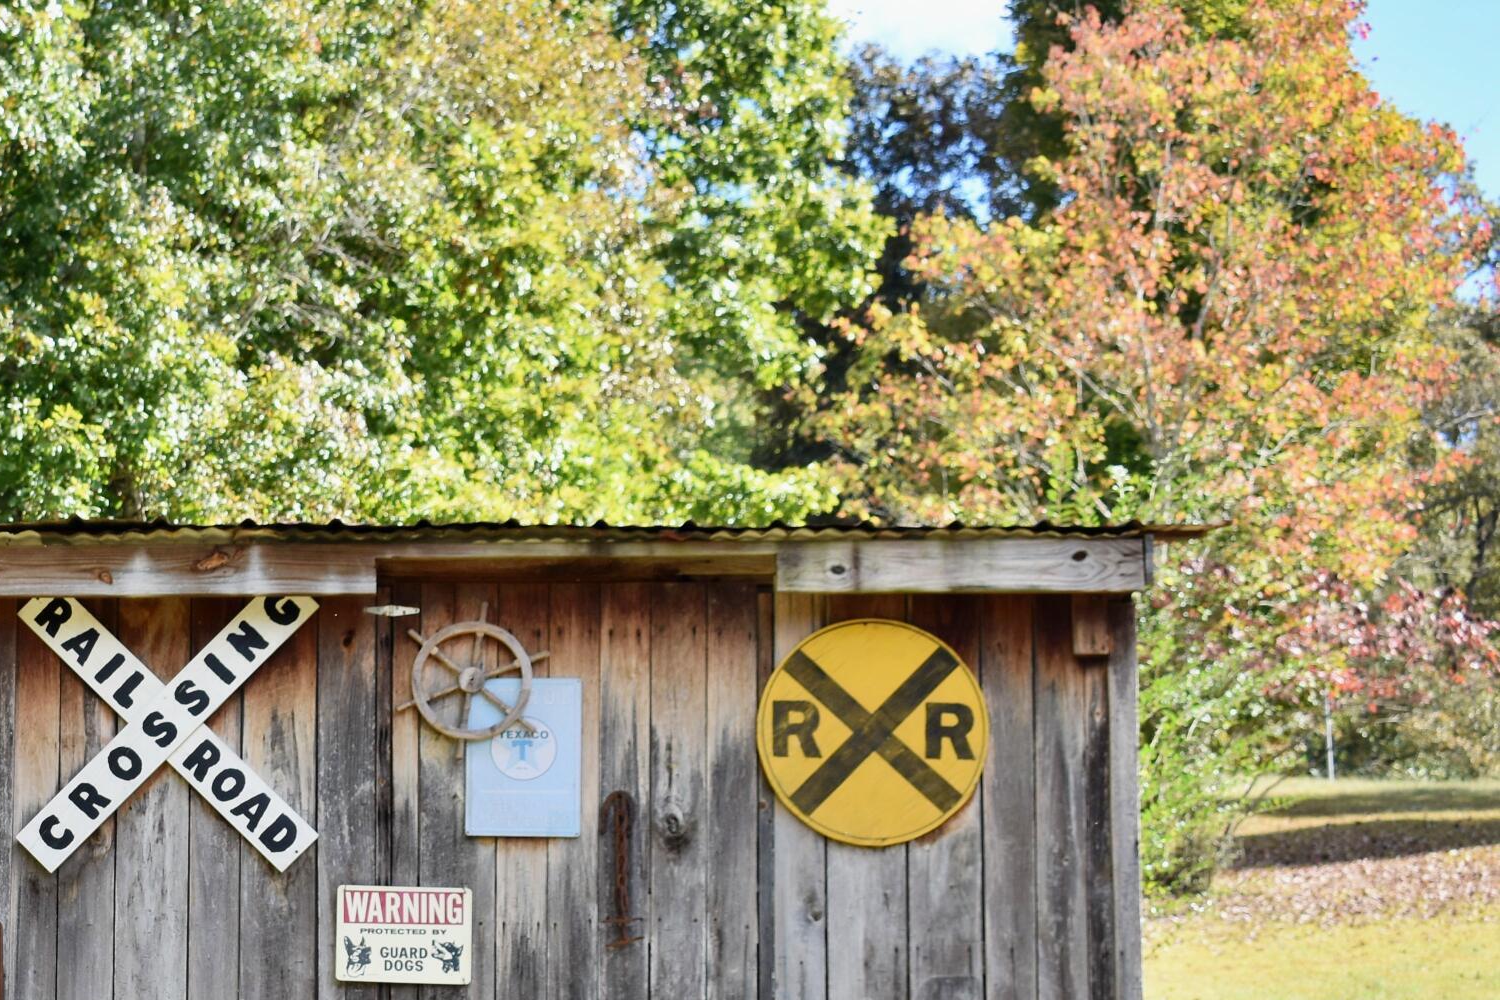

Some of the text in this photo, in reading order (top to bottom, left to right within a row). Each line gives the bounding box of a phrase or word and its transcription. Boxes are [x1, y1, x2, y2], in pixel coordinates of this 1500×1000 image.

[38, 596, 301, 851] CROSSING
[345, 891, 463, 924] WARNING
[380, 947, 428, 959] GUARD
[384, 960, 424, 971] DOGS
